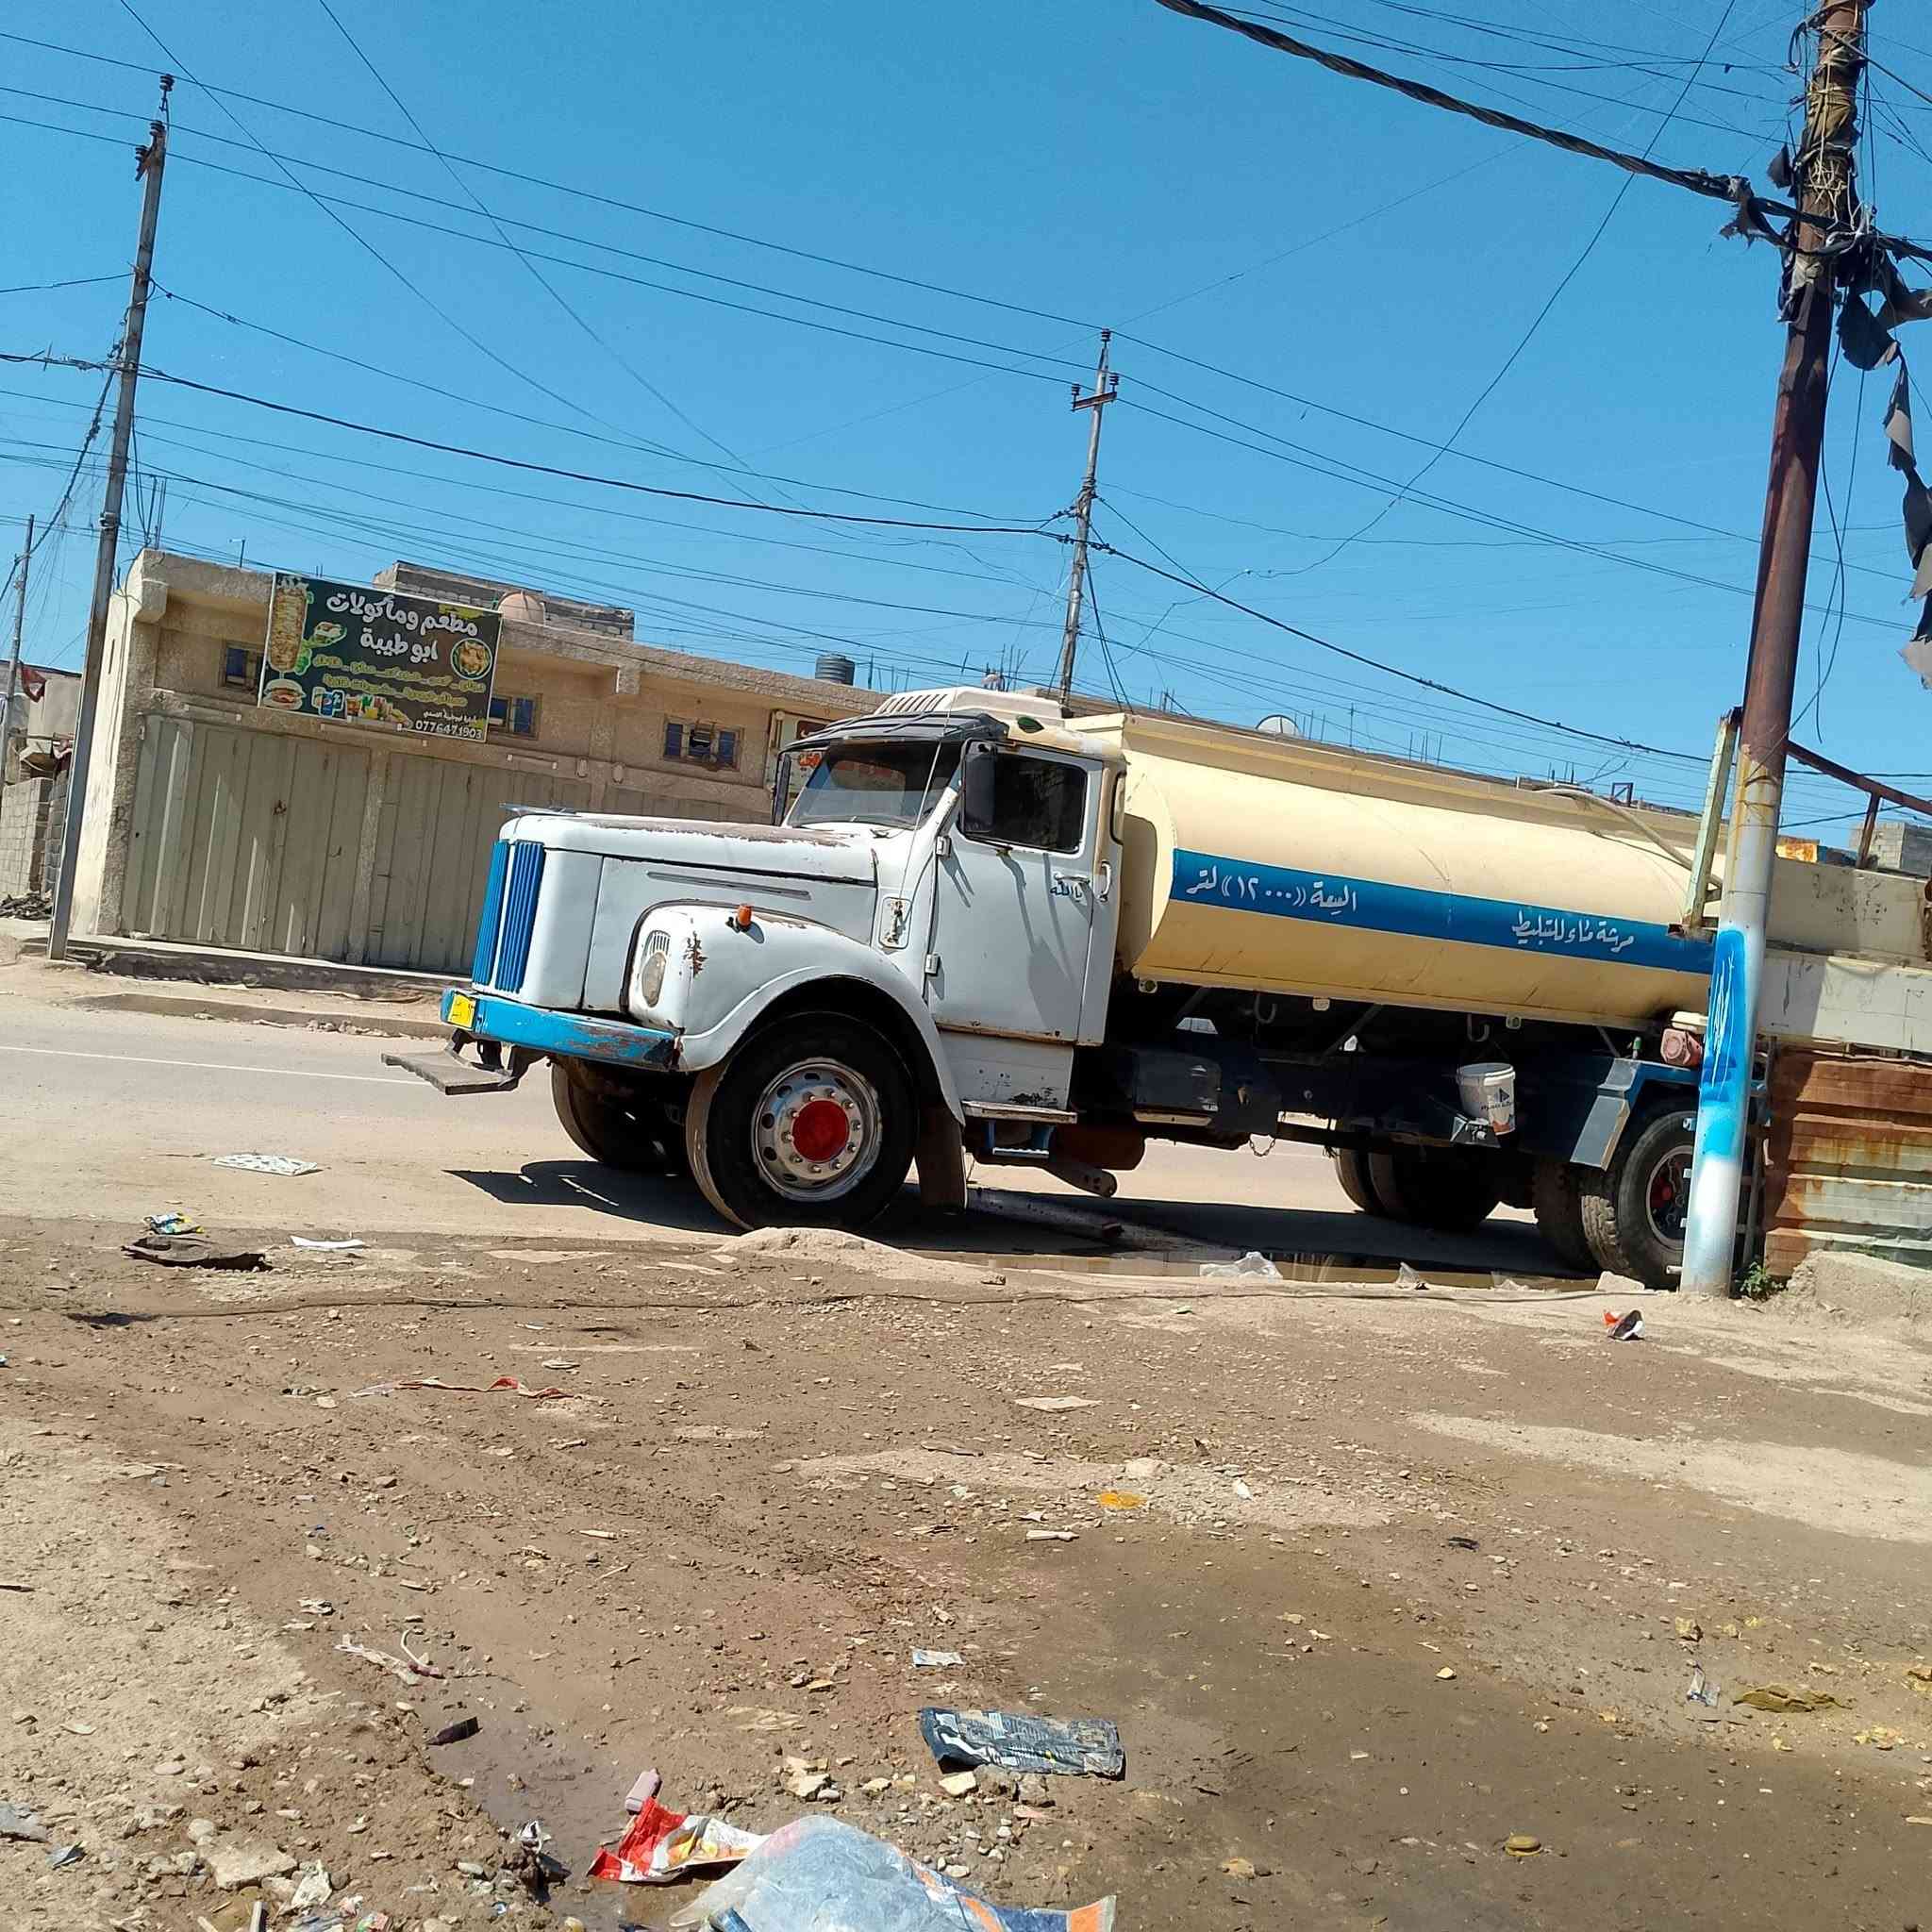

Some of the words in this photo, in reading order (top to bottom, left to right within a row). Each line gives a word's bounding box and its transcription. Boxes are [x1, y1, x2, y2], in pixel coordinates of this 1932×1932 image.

[421, 612, 478, 637] مطعم
[360, 627, 409, 657] طيبة
[1186, 864, 1218, 895] لتر
[1597, 920, 1635, 954] مرشة
